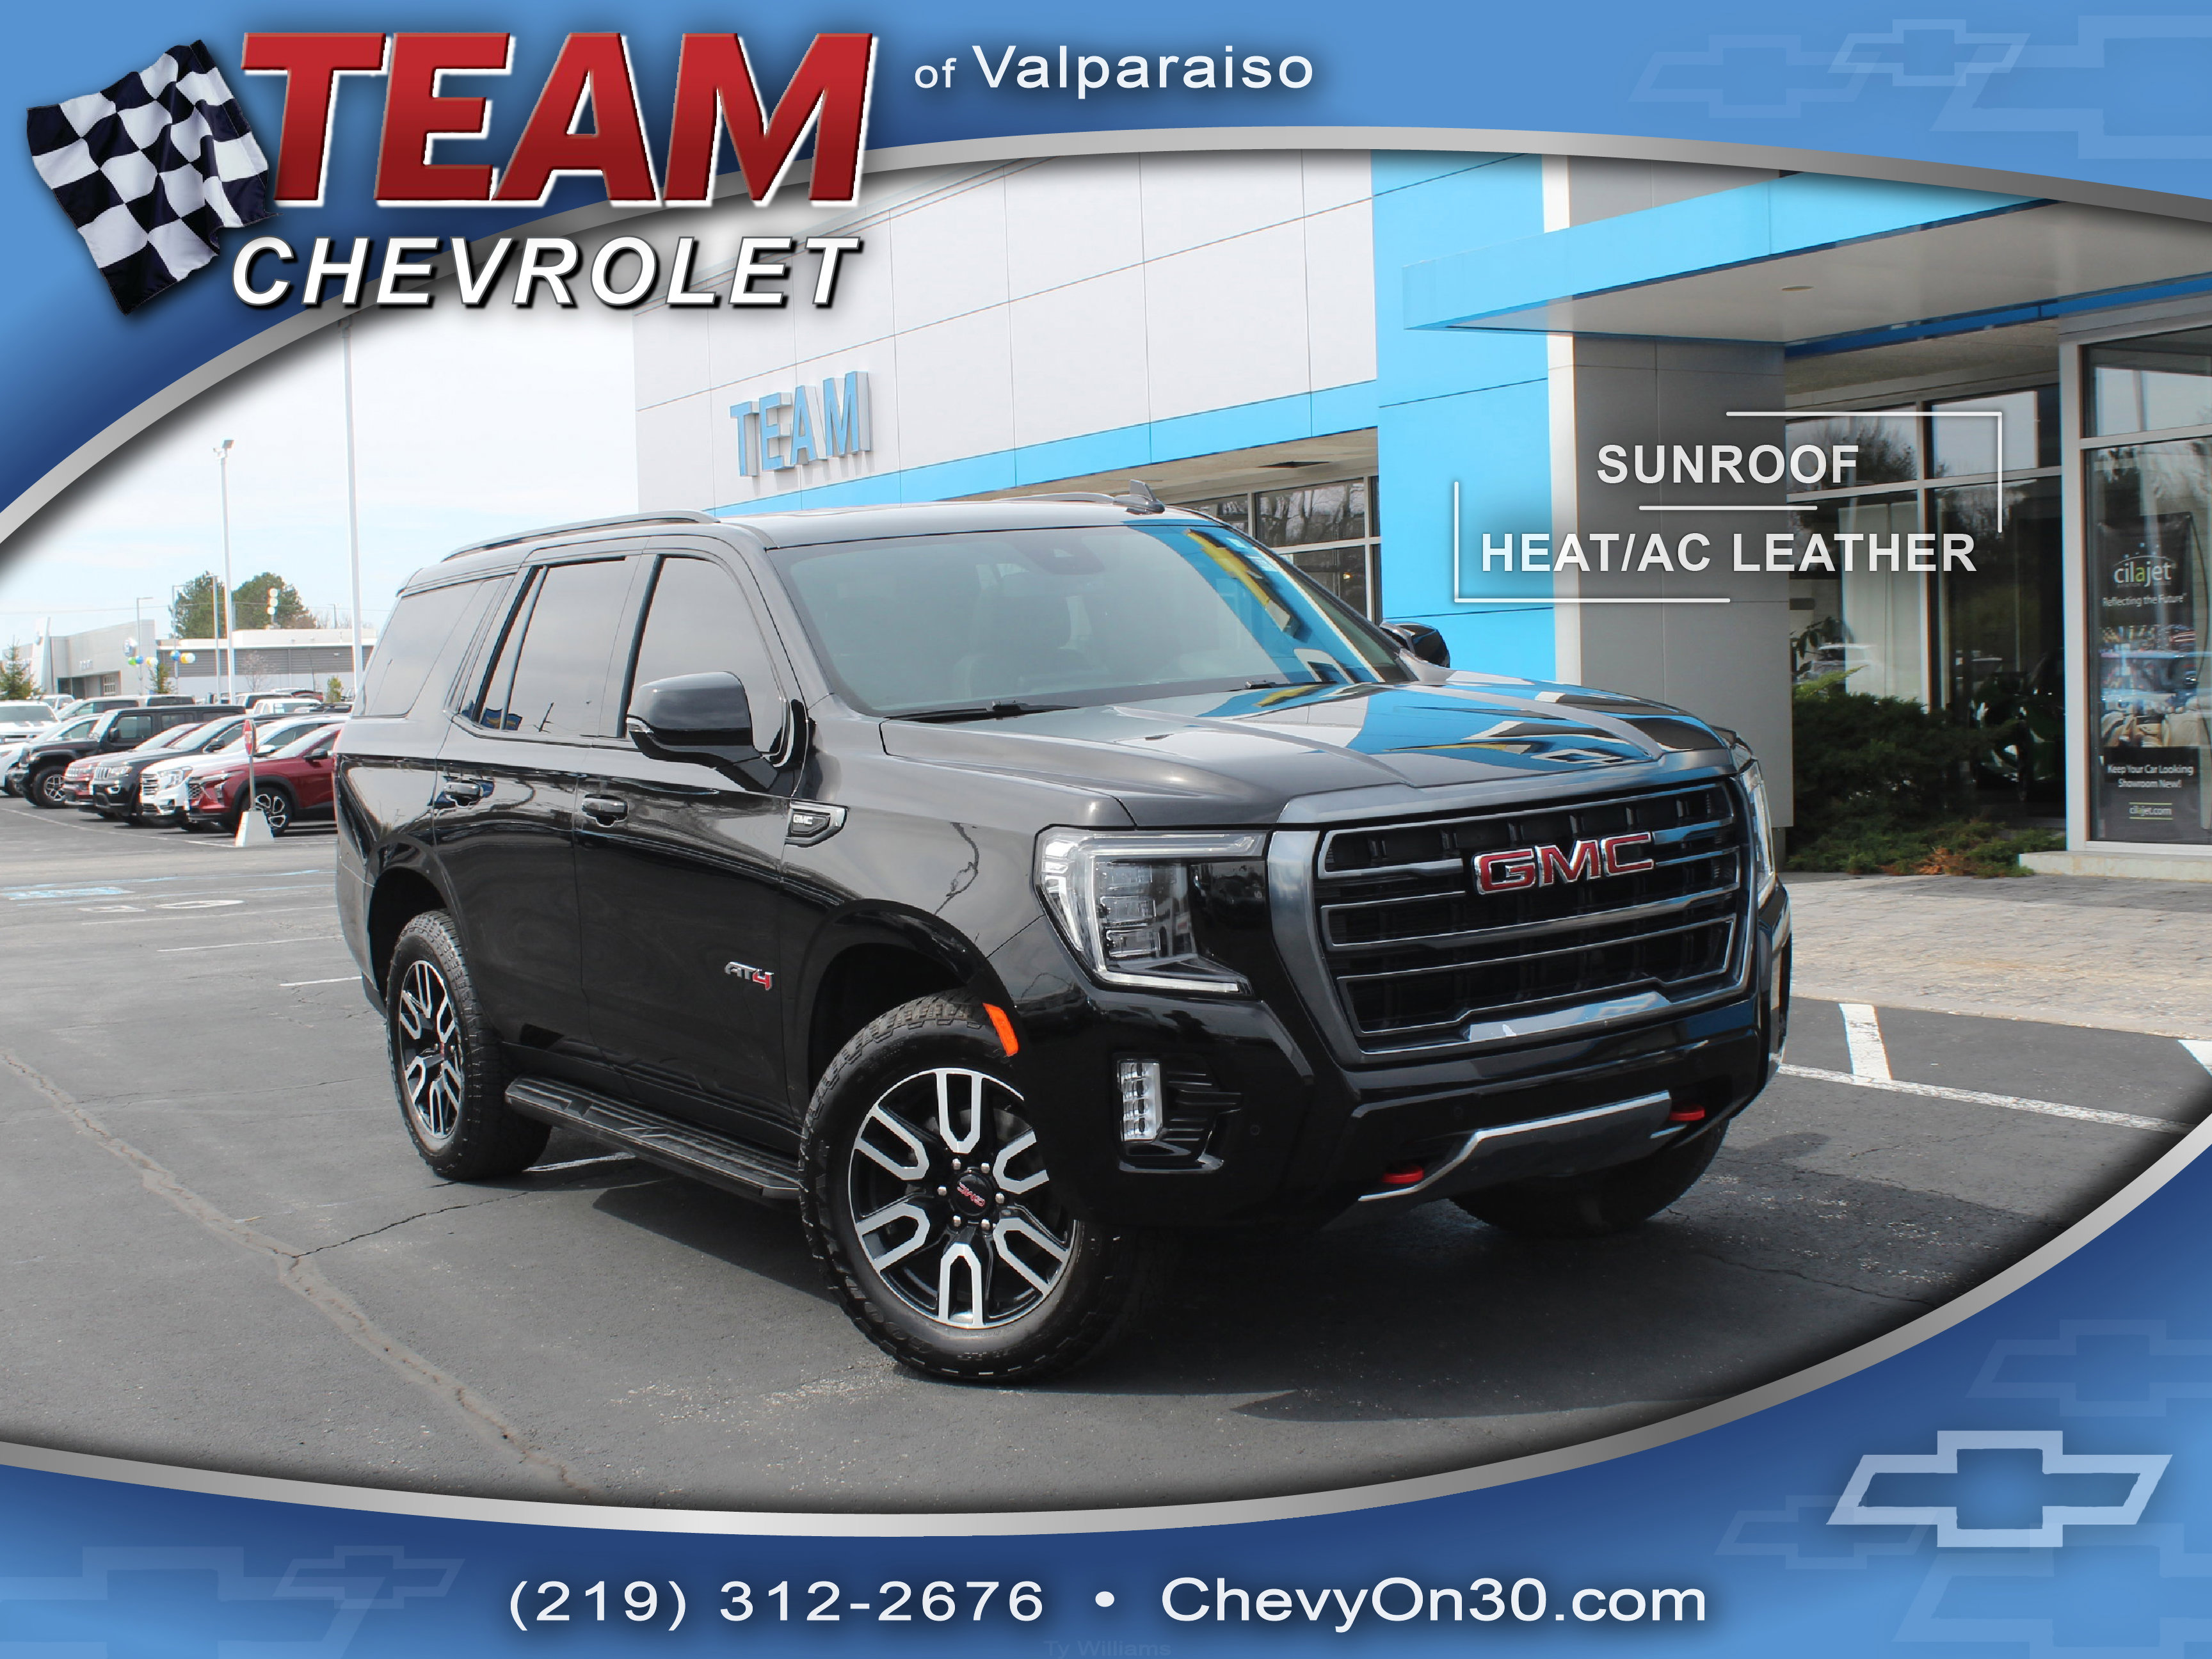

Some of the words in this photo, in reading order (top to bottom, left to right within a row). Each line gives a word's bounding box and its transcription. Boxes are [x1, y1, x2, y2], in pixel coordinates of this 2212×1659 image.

[730, 371, 871, 477] TEAM
[2113, 561, 2172, 587] cilajet
[2103, 596, 2142, 607] Reflecting
[2143, 595, 2158, 604] the
[2108, 764, 2126, 774] Keep
[2126, 765, 2144, 773] Your
[2145, 764, 2158, 773] Car
[2159, 764, 2194, 776] Looking
[2119, 778, 2158, 788] Showroom
[793, 815, 813, 825] GMC
[2129, 805, 2172, 817] cilajet.com
[1473, 832, 1655, 894] GMC
[725, 961, 774, 991] AT4
[957, 1182, 985, 1206] GMC
